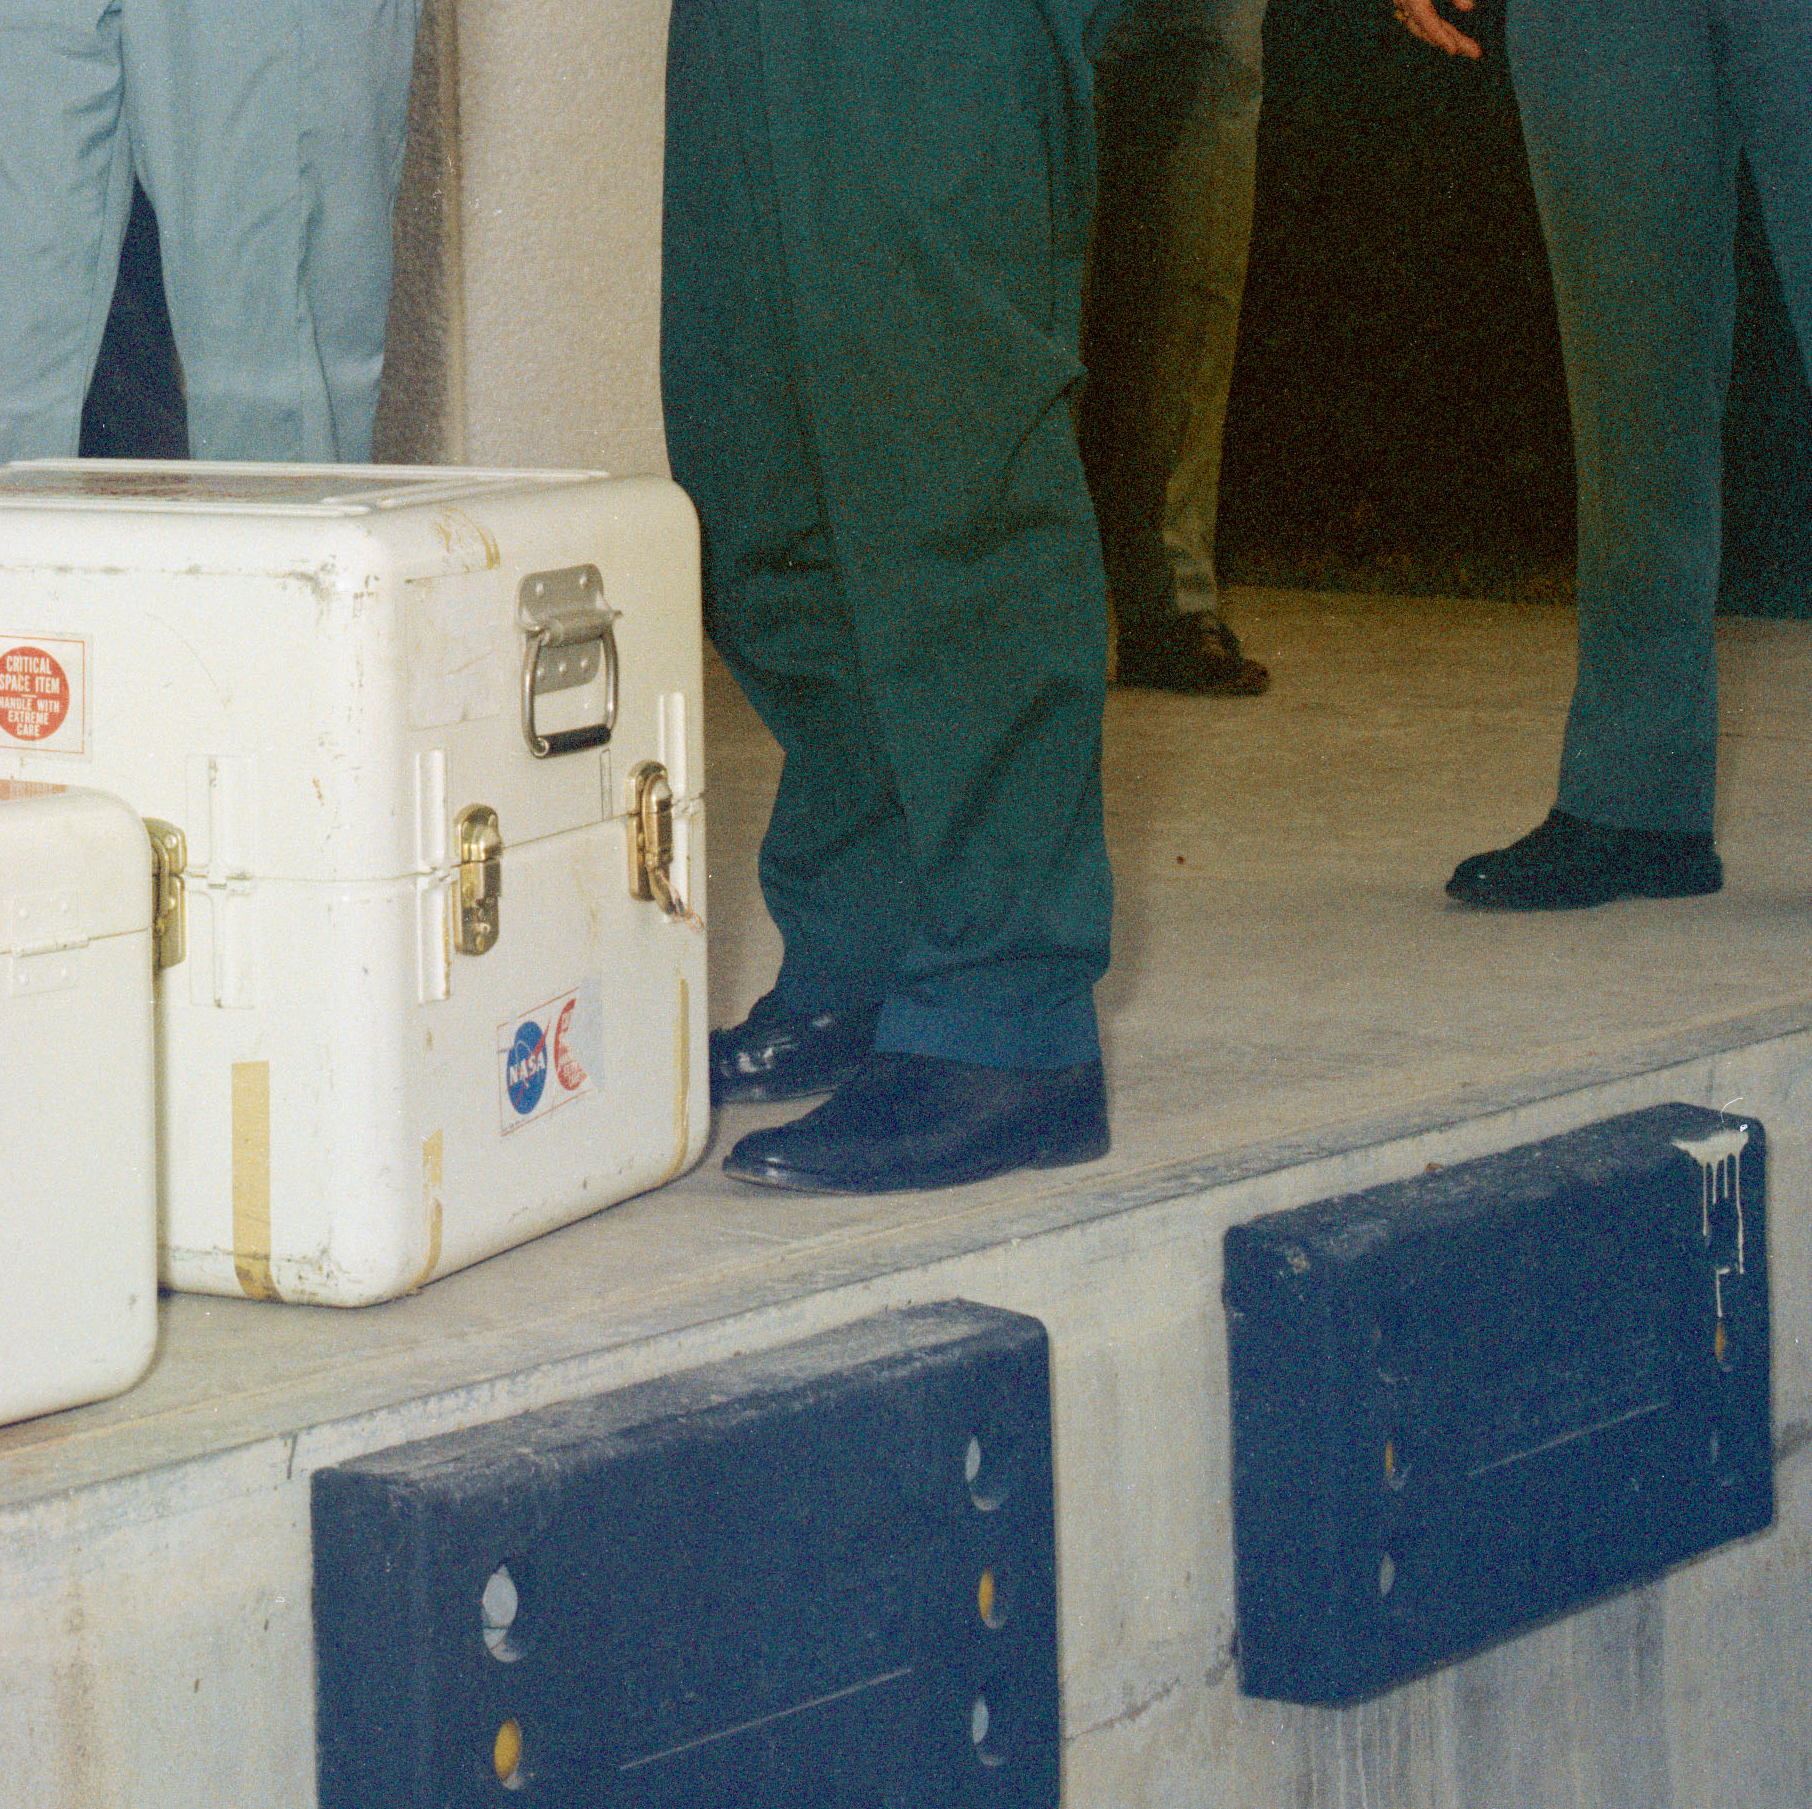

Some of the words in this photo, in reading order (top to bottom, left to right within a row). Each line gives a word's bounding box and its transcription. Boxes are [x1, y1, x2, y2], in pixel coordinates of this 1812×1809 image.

[6, 655, 52, 675] CRITICAL
[35, 676, 60, 694] ITEM
[37, 699, 60, 713] WITH
[8, 710, 49, 725] EXTREME
[16, 724, 40, 736] CARE
[509, 1051, 546, 1087] NASA
